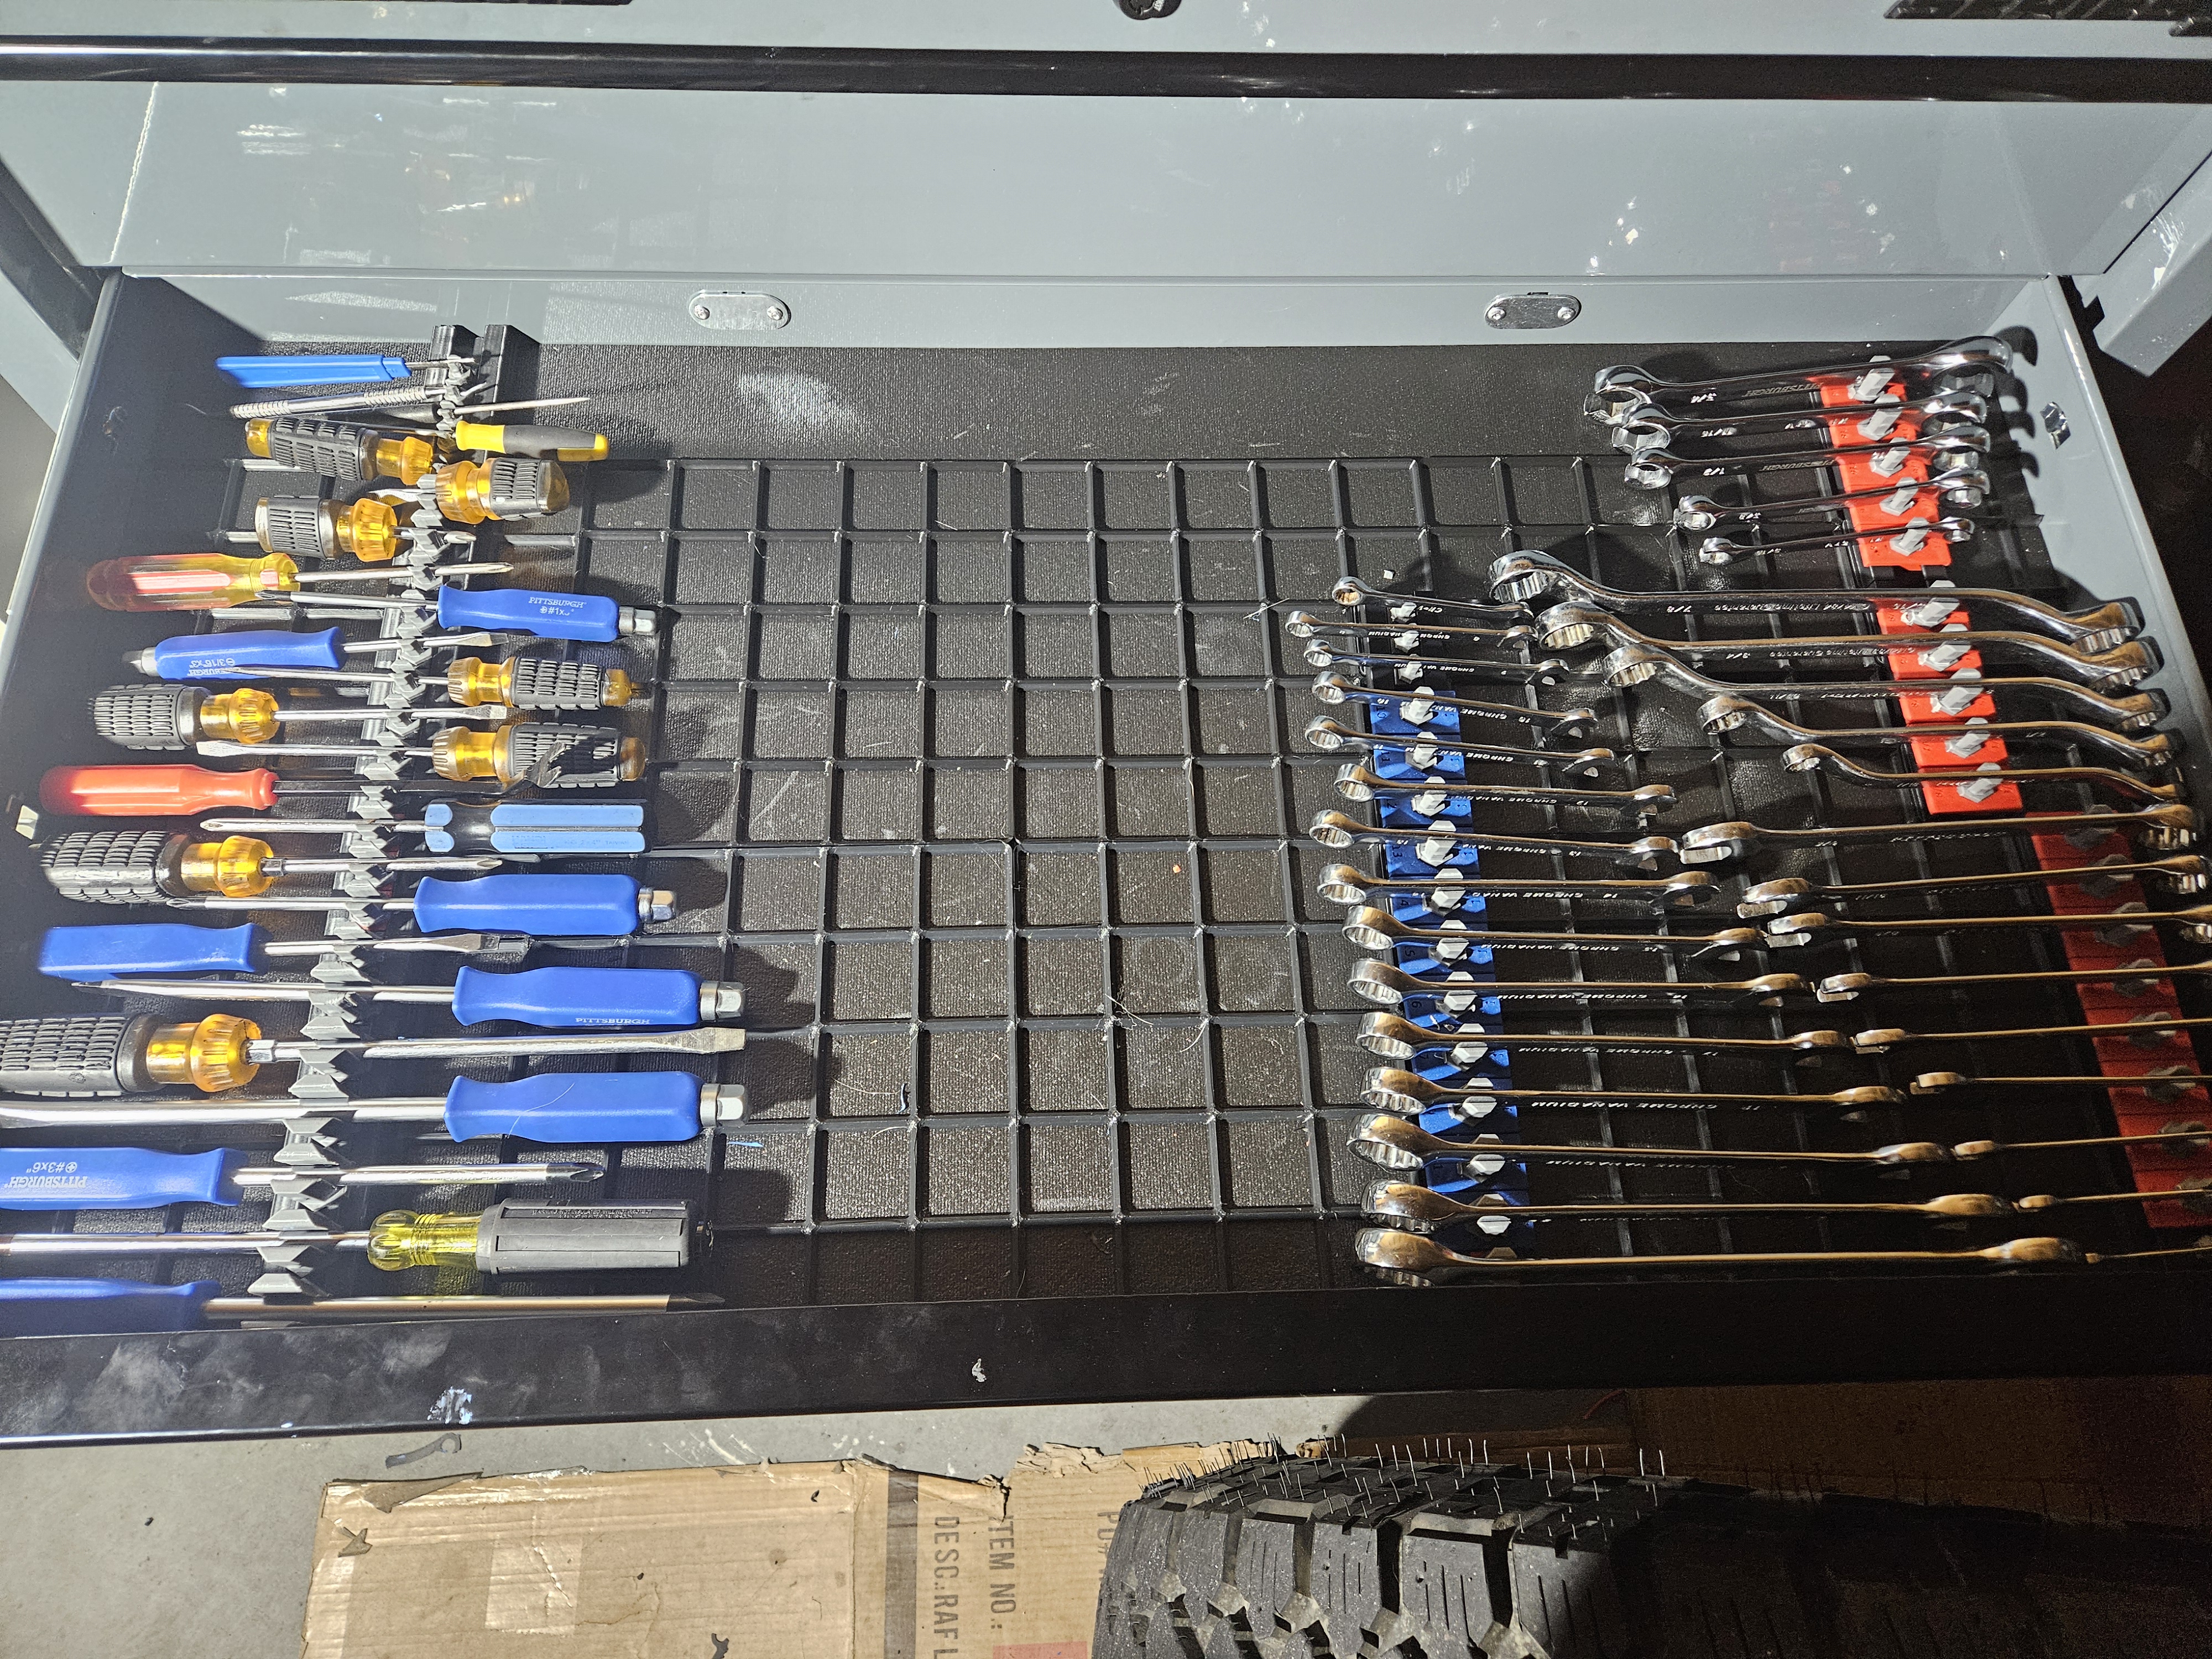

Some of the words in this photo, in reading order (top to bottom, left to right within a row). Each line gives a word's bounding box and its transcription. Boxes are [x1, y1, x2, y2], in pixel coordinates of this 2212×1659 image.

[1741, 383, 1824, 397] PITTSBURGH
[528, 597, 586, 608] PITTSBURGH
[8, 1176, 88, 1188] PITTSBURGH
